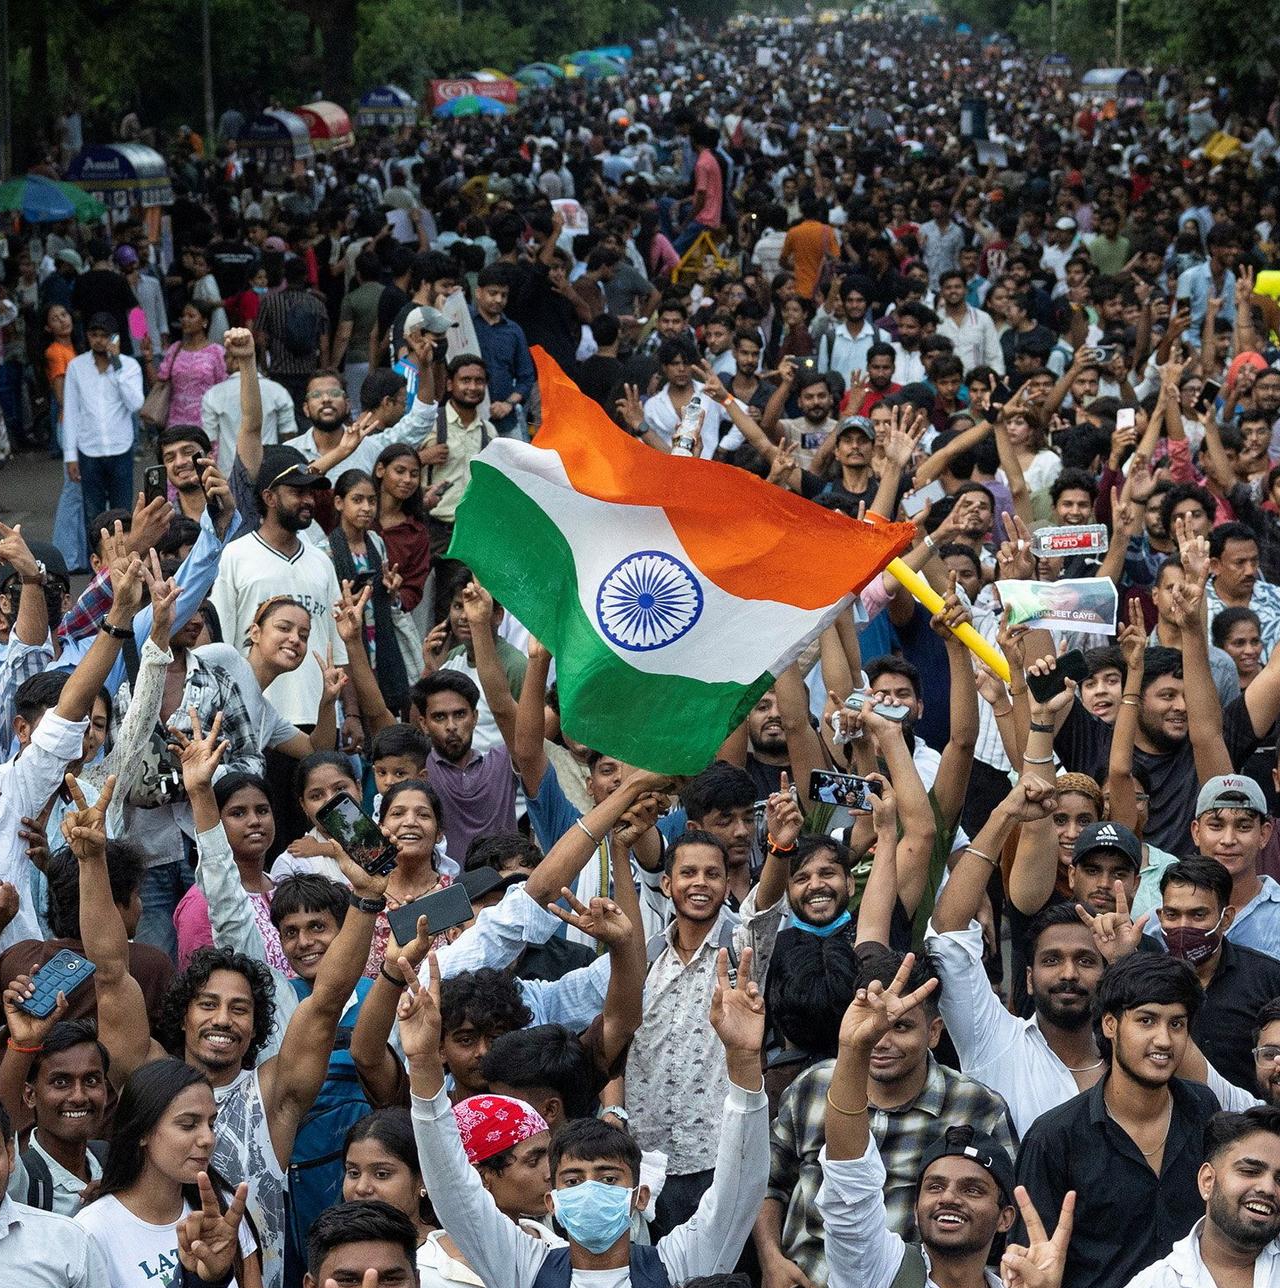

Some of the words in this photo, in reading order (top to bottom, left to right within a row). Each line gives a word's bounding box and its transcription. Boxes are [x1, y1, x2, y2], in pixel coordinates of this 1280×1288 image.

[1053, 610, 1072, 619] JEET
[1073, 611, 1096, 621] GAYE!
[1095, 833, 1119, 841] adidas
